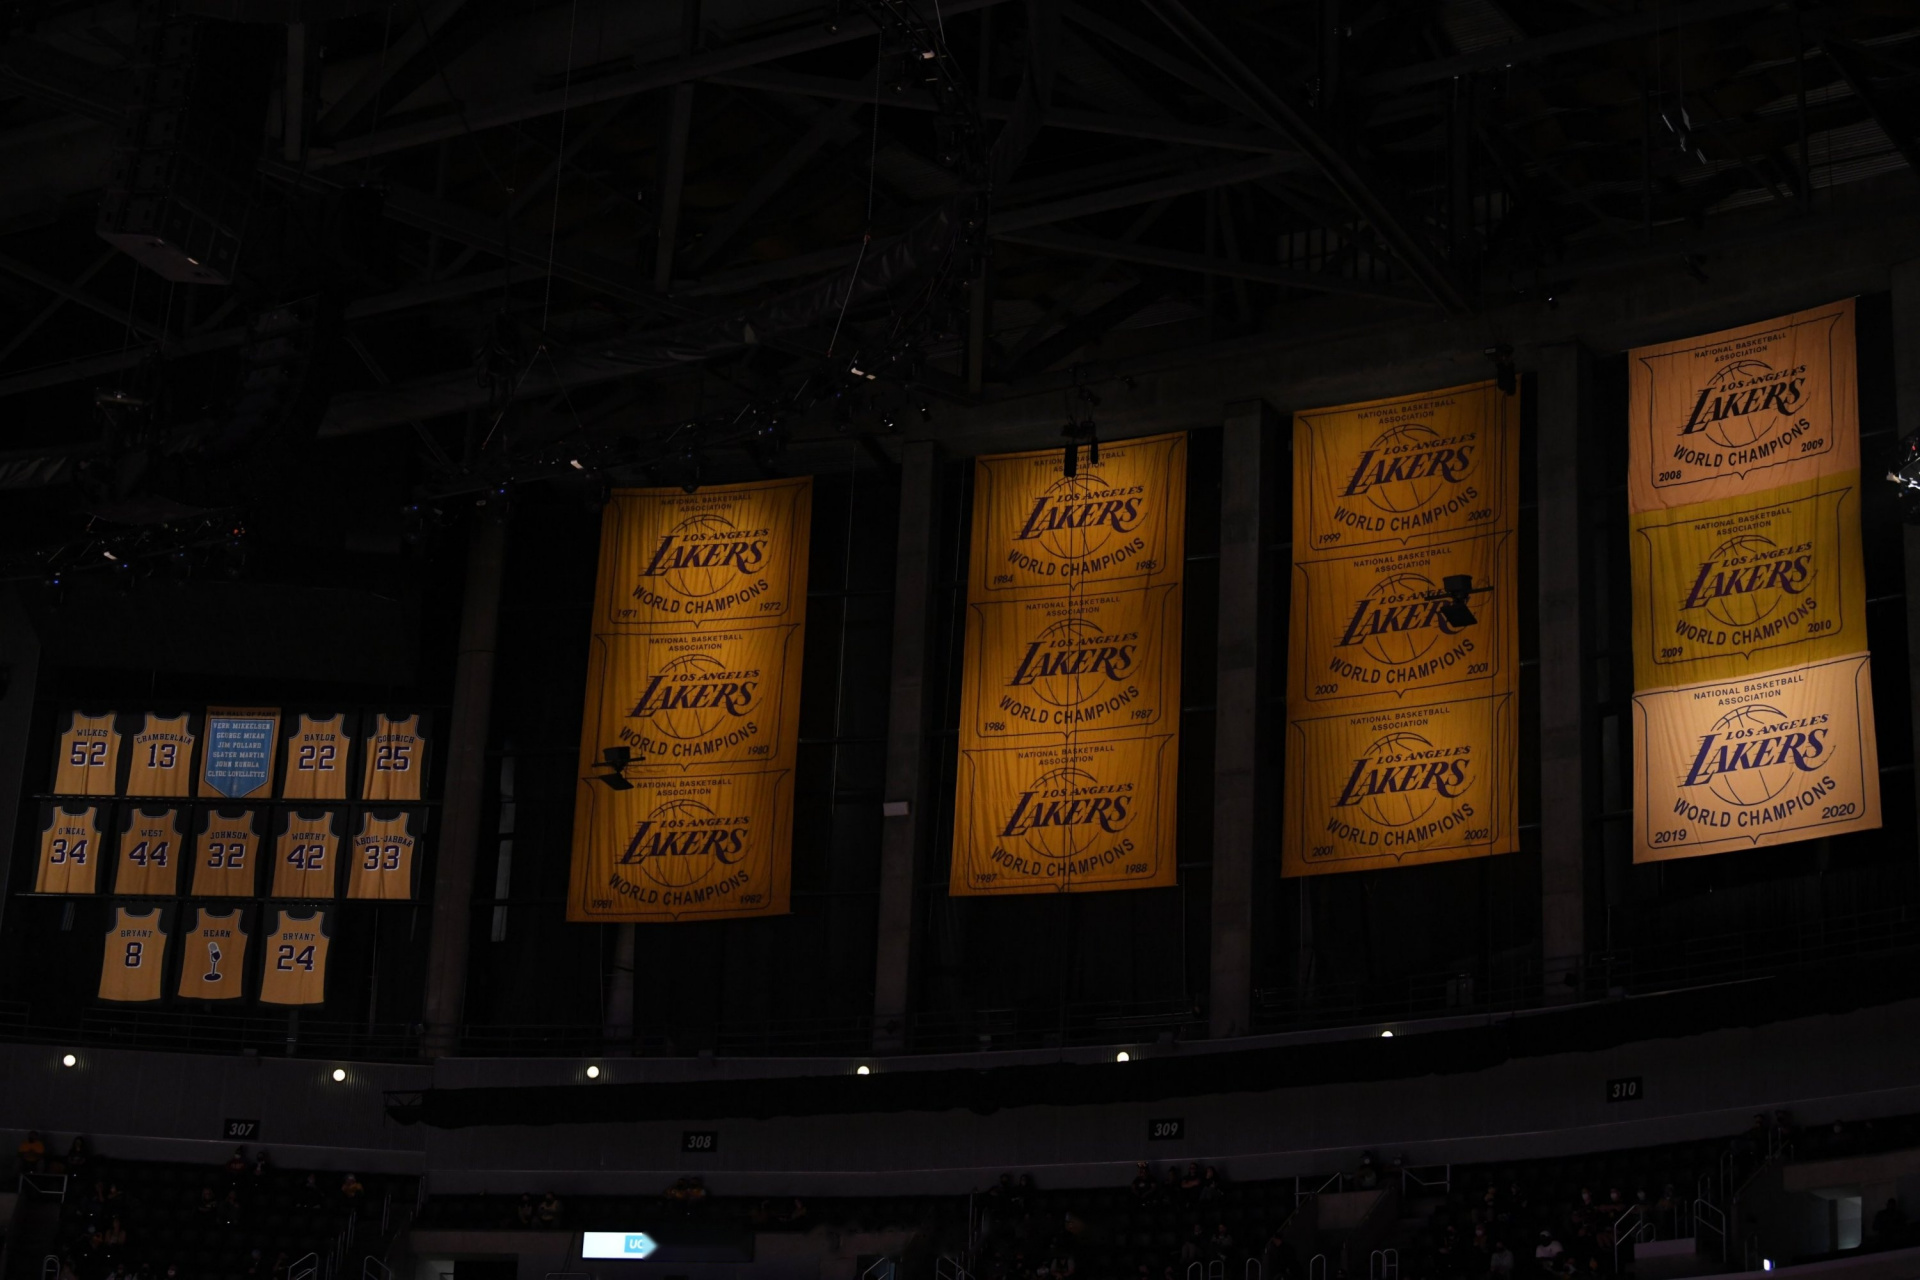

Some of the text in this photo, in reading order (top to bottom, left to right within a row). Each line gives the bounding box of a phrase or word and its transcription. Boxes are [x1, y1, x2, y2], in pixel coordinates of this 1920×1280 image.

[1695, 333, 1786, 358] NATIONAL BASKETBALL
[1715, 346, 1767, 362] ASSOCIATION
[1720, 365, 1806, 392] LOS ANGELES
[1358, 400, 1455, 419] NATIONAL BASKETBALL
[1677, 378, 1805, 436] LAKERS
[1379, 411, 1434, 424] ASSOCIATION
[1384, 433, 1476, 455] LOS ANGELES
[1674, 418, 1810, 467] WORLD CHAMPIONS
[1801, 439, 1823, 452] 2009
[1338, 445, 1475, 497] LAKERS
[1659, 470, 1682, 481] 2008
[661, 495, 751, 505] NATIONAL BASKETBALL
[1057, 486, 1144, 502] LOS ANGELES
[680, 504, 732, 512] ASSOCIATION
[1334, 486, 1478, 531] WORLD CHAMPIONS
[1468, 509, 1491, 521] 2000
[1012, 497, 1142, 540] LAKERS
[1695, 508, 1791, 530] NATIONAL BASKETBALL
[683, 528, 769, 541] LOS ANGELES
[1717, 521, 1771, 536] ASSOCIATION
[1319, 533, 1340, 544] 1999
[639, 535, 768, 576] LAKERS
[1008, 537, 1145, 576] WORLD CHAMPIONS
[1354, 548, 1452, 567] NATIONAL BASKETBALL
[1723, 542, 1812, 567] LOS ANGELES
[1375, 559, 1430, 573] ASSOCIATION
[1679, 556, 1811, 611] LAKERS
[632, 579, 768, 614] WORLD CHAMPIONS
[1026, 597, 1119, 610] NATIONAL BASKETBALL
[1380, 595, 1403, 605] LOS
[759, 602, 781, 611] 1972
[1046, 607, 1099, 616] ASSOCIATION
[1676, 597, 1817, 645] WORLD CHAMPIONS
[1808, 620, 1831, 633] 2010
[650, 634, 743, 645] NATIONAL BASKETBALL
[1050, 632, 1138, 648] LOS ANGELES
[1662, 647, 1683, 657] 2009
[1004, 642, 1136, 686] LAKERS
[1329, 638, 1475, 683] WORLD CHAMPIONS
[1467, 663, 1488, 674] 2001
[672, 670, 760, 682] LOS ANGELES
[1315, 684, 1337, 695] 2000
[1694, 676, 1804, 700] NATIONAL BASKETBALL
[625, 676, 758, 717] LAKERS
[1718, 690, 1781, 706] ASSOCIATION
[1000, 686, 1139, 724] WORLD CHAMPIONS
[1131, 710, 1153, 719] 1987
[1350, 708, 1449, 725] NATIONAL BASKETBALL
[984, 722, 1005, 731] 1986
[1372, 719, 1428, 731] ASSOCIATION
[1726, 714, 1828, 740] LOS ANGELES
[137, 734, 192, 744] CHAMBERLAIN
[377, 735, 414, 743] GOODRICH
[619, 722, 758, 757] WORLD CHAMPIONS
[71, 742, 107, 767] 52
[148, 744, 177, 769] 13
[1062, 745, 1114, 754] BASKETBALL
[1377, 746, 1470, 764] LOS ANGELES
[299, 746, 335, 770] 22
[377, 746, 411, 771] 25
[1039, 756, 1093, 765] ASSOCIATION
[1677, 729, 1828, 787] LAKERS
[680, 779, 732, 787] BASKETBALL
[1042, 783, 1133, 798] LOS ANGELES
[1330, 758, 1469, 808] LAKERS
[1674, 776, 1835, 827] WORLD CHAMPIONS
[997, 792, 1131, 837] LAKERS
[1822, 803, 1855, 818] 2020
[660, 817, 749, 828] LOS ANGELES
[1327, 803, 1474, 846] WORLD CHAMPIONS
[292, 833, 325, 841] WORTHY
[356, 836, 412, 847] ABDUL-JABBAR
[614, 821, 748, 864] LAKERS
[1465, 829, 1488, 840] 2002
[1655, 829, 1686, 843] 2019
[51, 840, 88, 864] 34
[129, 842, 169, 867] 44
[208, 844, 244, 868] 32
[288, 845, 324, 870] 42
[364, 846, 400, 870] 33
[992, 839, 1134, 876] WORLD CHAMPIONS
[1312, 846, 1333, 856] 2001
[1125, 863, 1147, 873] 1988
[976, 874, 997, 882] 1987
[609, 870, 749, 905] WORLD CHAMPIONS
[283, 933, 315, 941] BRYANT
[125, 942, 143, 967] 8
[277, 945, 316, 971] 24
[1612, 1081, 1636, 1098] 310
[230, 1123, 254, 1136] 307
[1154, 1122, 1178, 1136] 309
[688, 1136, 711, 1148] 308
